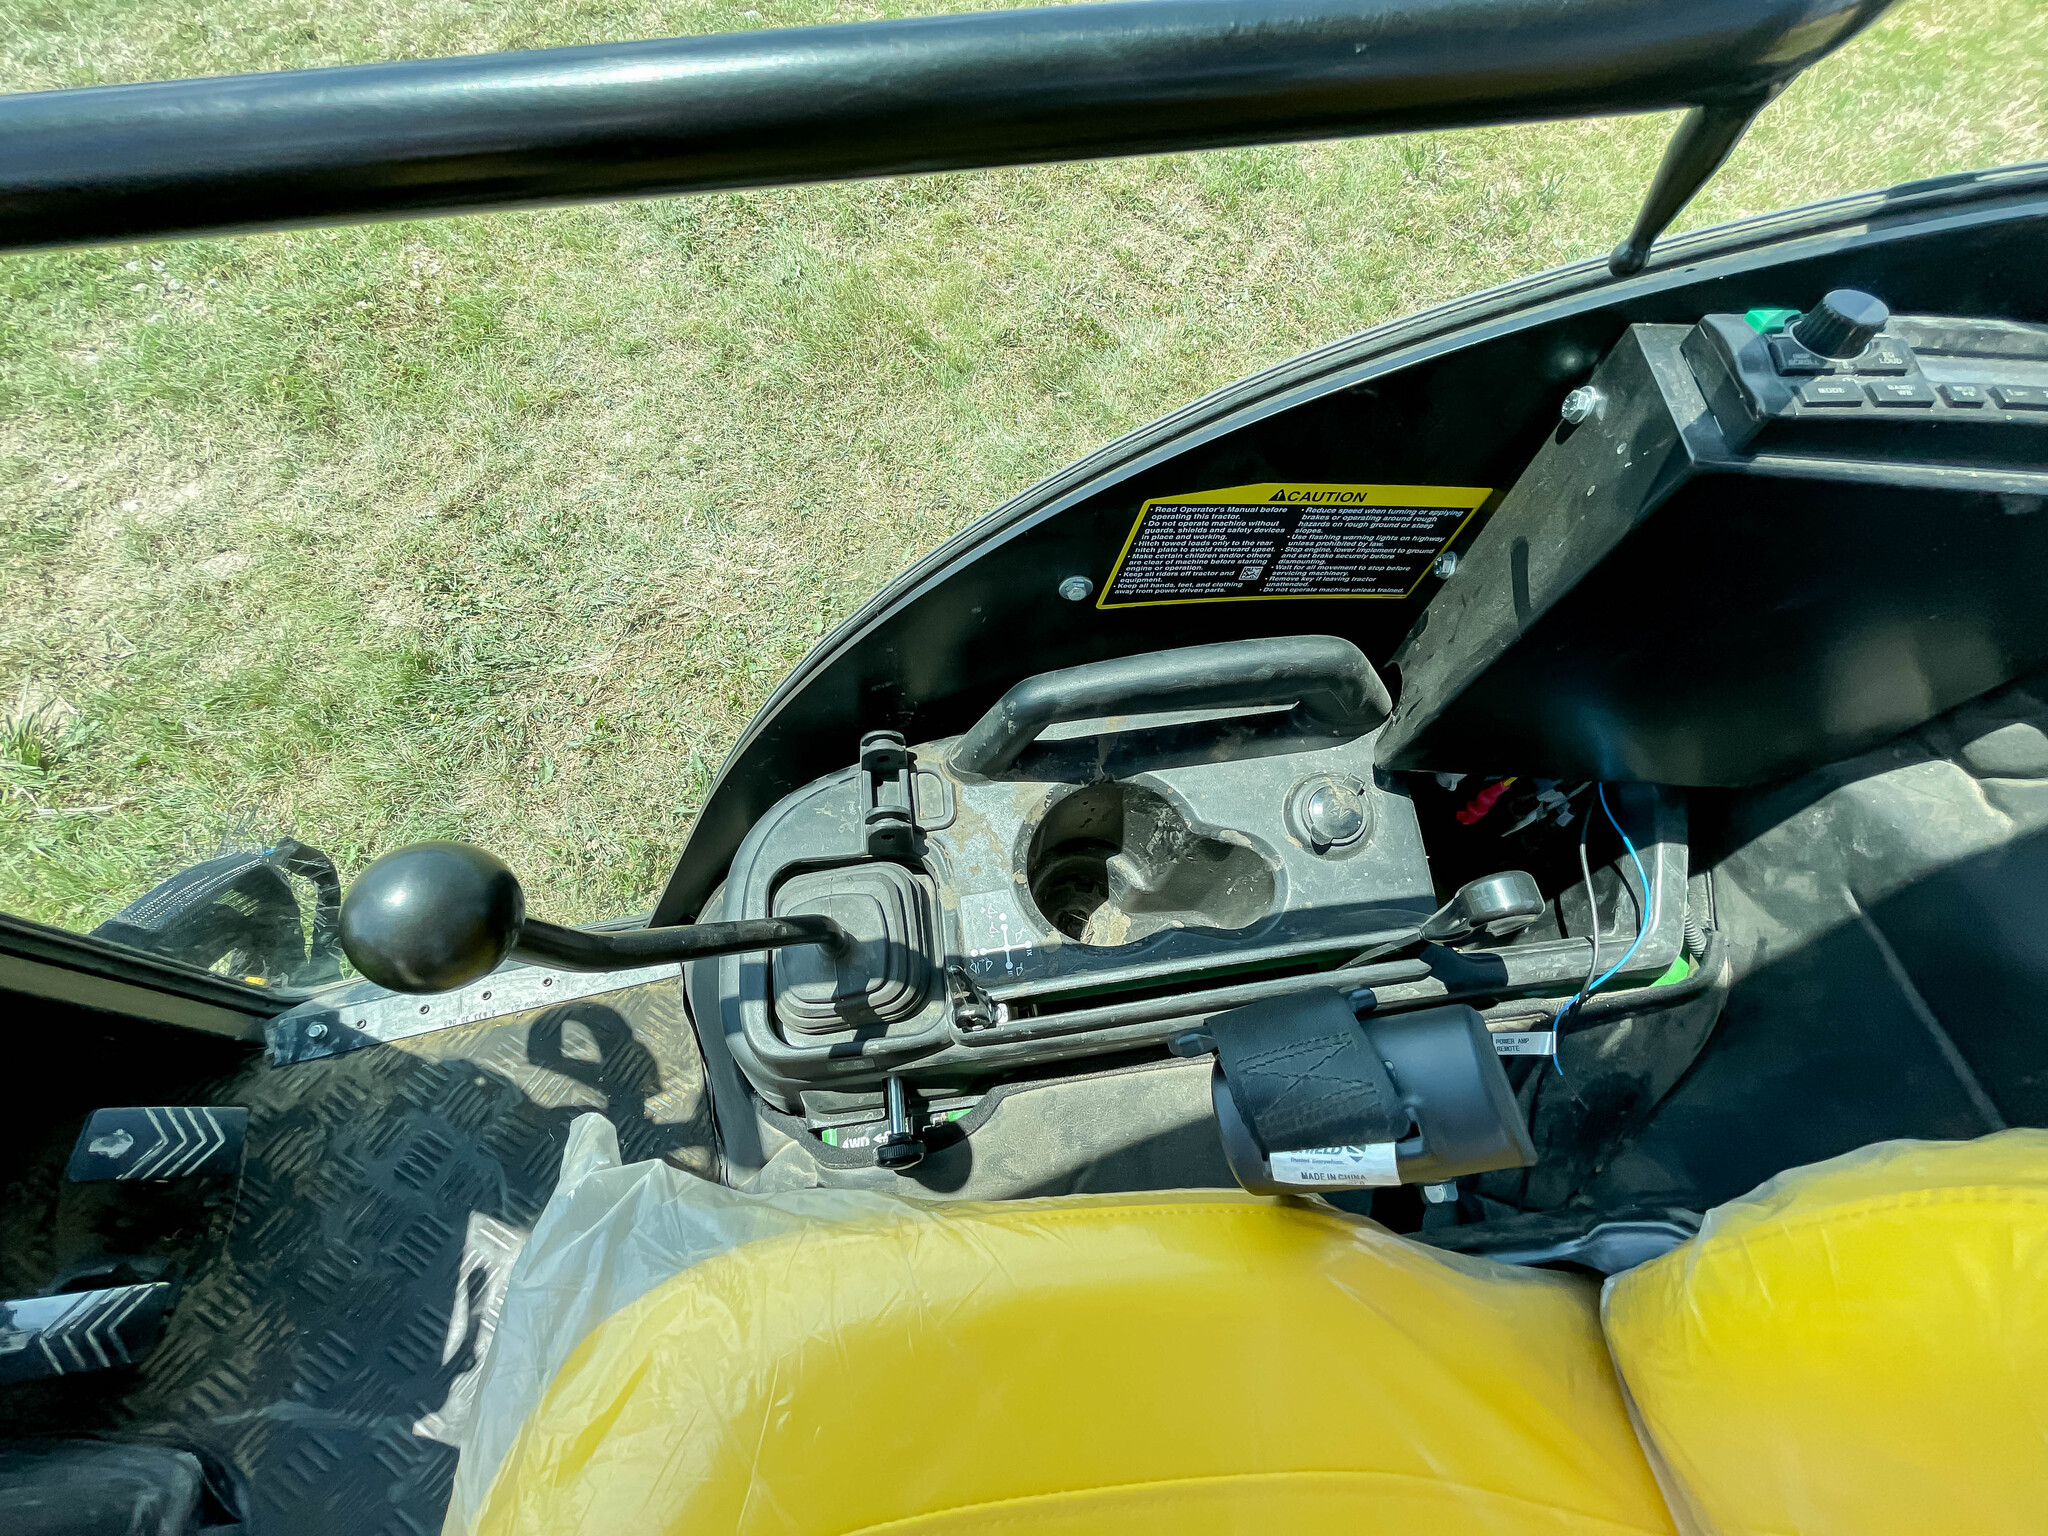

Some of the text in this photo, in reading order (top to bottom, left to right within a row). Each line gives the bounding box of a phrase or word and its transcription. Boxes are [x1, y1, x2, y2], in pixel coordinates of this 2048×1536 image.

[1287, 491, 1367, 502] CAUTION
[842, 1136, 870, 1148] 4WD
[1301, 1172, 1325, 1180] MADE
